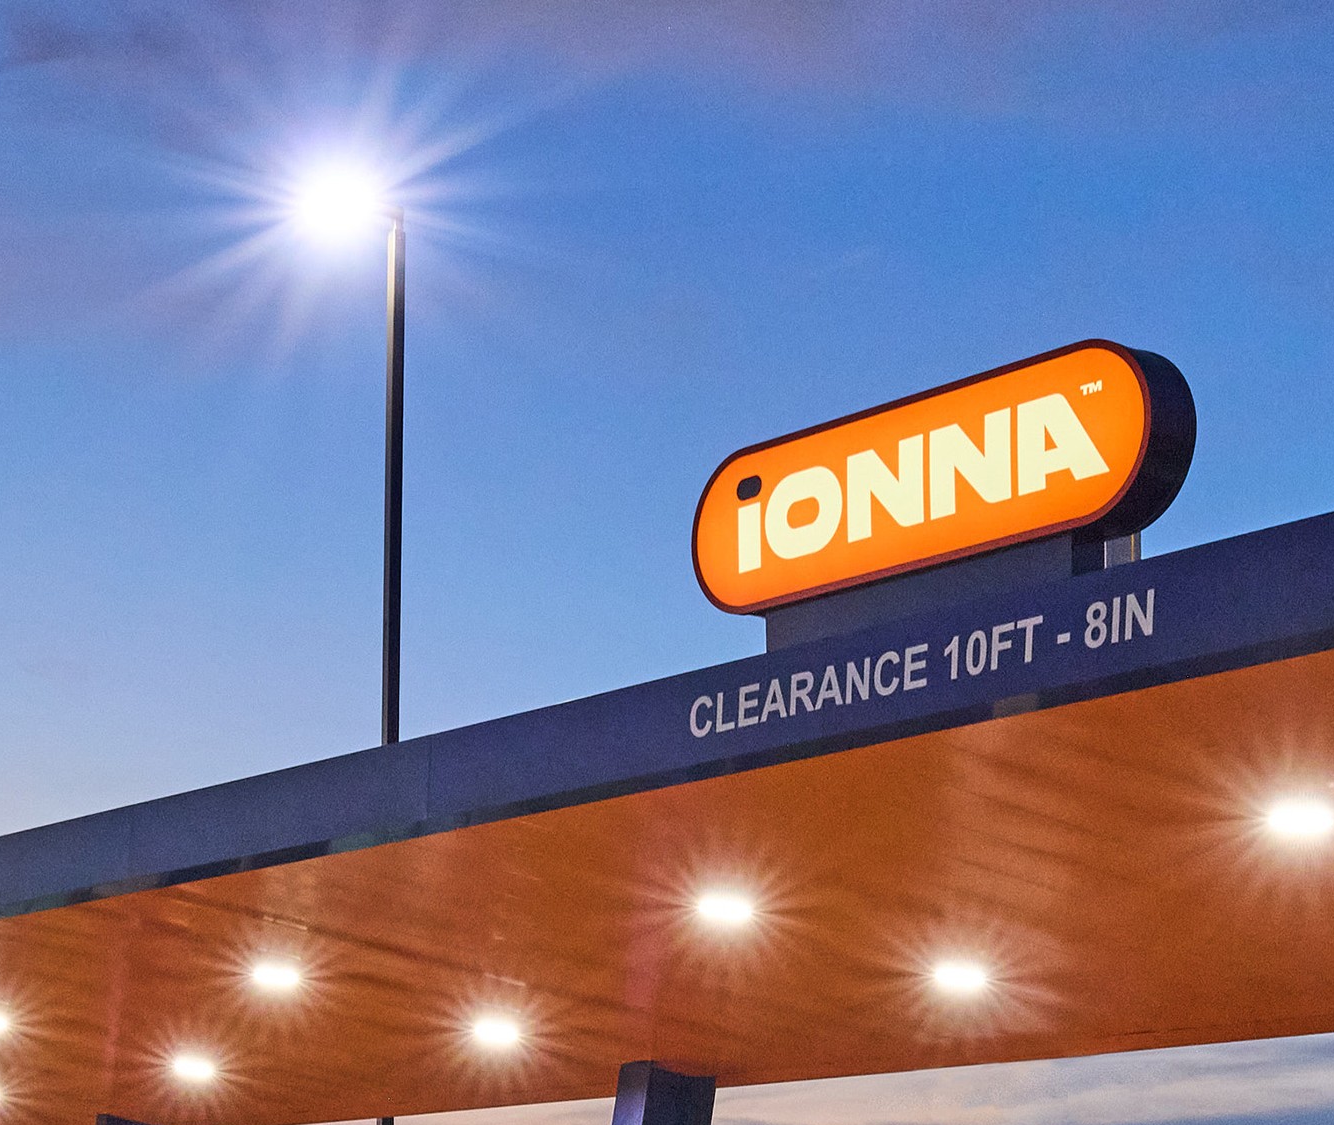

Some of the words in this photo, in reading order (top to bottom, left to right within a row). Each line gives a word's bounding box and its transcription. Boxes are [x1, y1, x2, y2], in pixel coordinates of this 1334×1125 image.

[690, 643, 929, 738] CLEARANCE
[943, 615, 1043, 680] 10FT
[1057, 632, 1070, 645] -
[1085, 589, 1156, 649] 8IN
